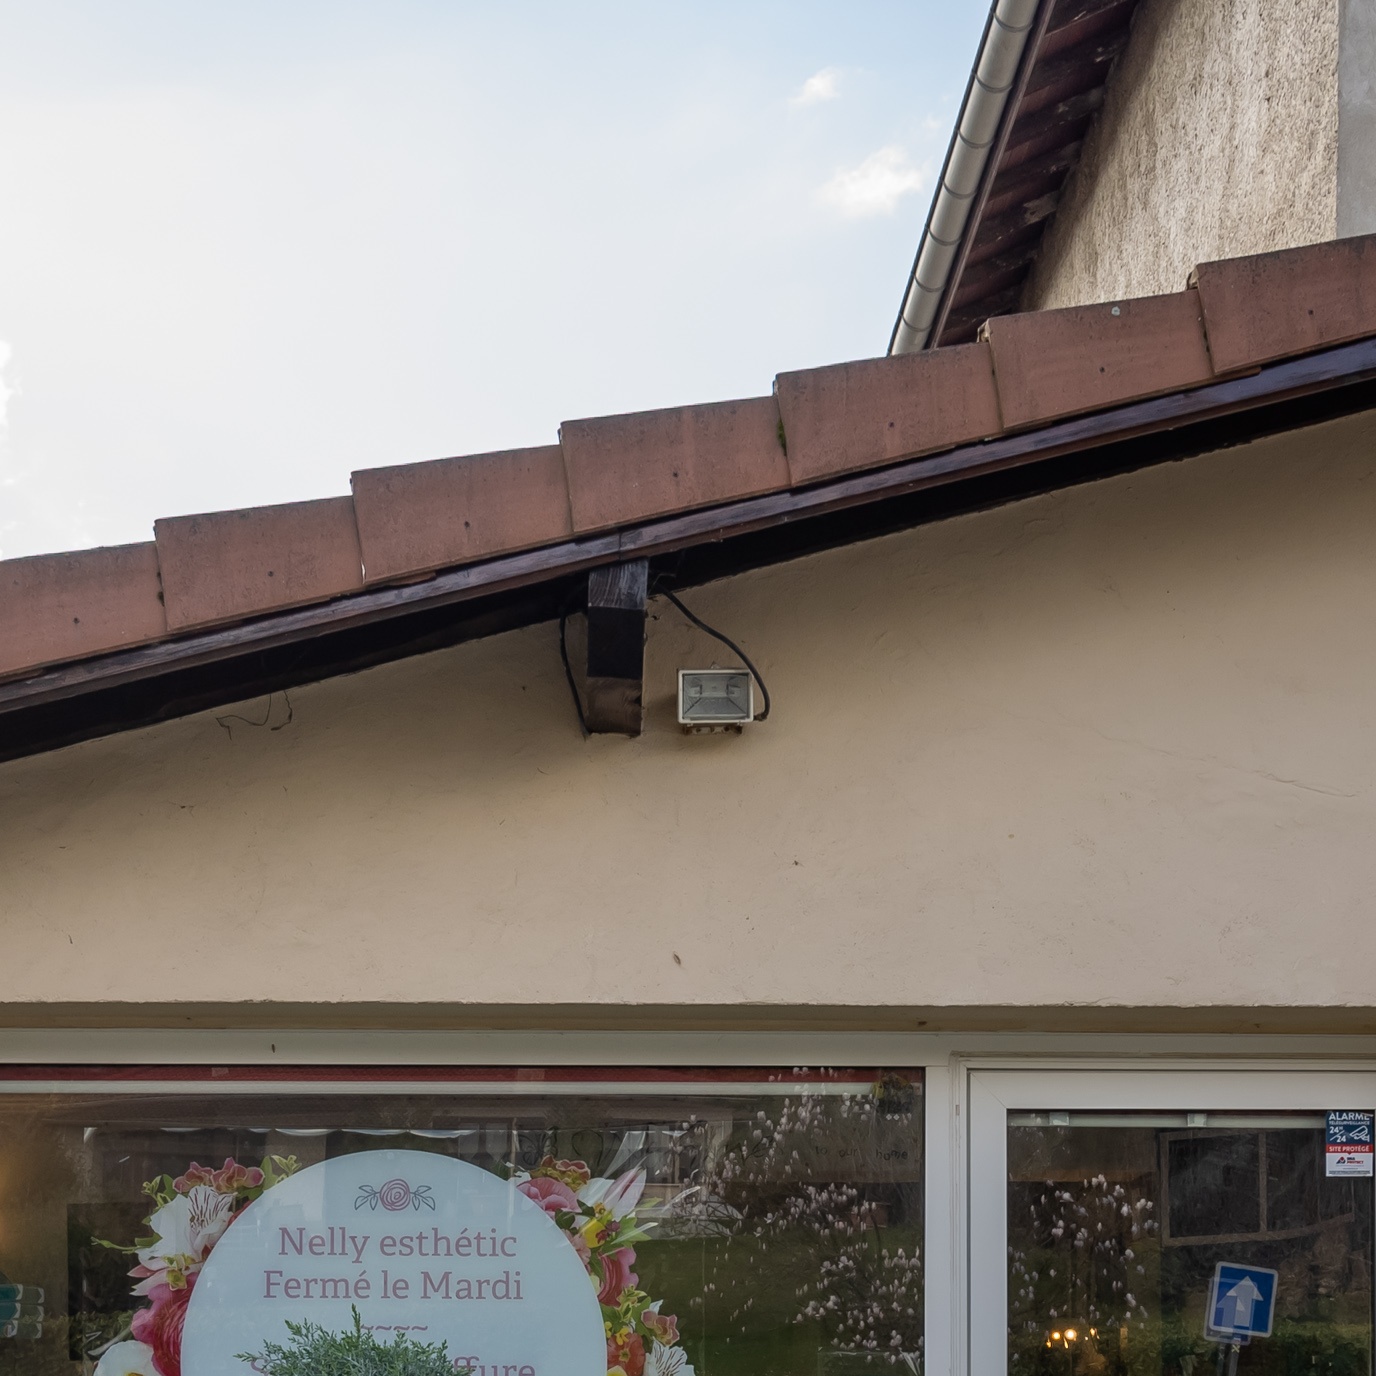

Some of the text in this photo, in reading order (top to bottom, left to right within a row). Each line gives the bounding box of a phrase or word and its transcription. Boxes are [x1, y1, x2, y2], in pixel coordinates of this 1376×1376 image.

[875, 1150, 909, 1161] home
[278, 1227, 518, 1263] Nelly esthétic
[263, 1269, 524, 1300] Fermé le Mardi
